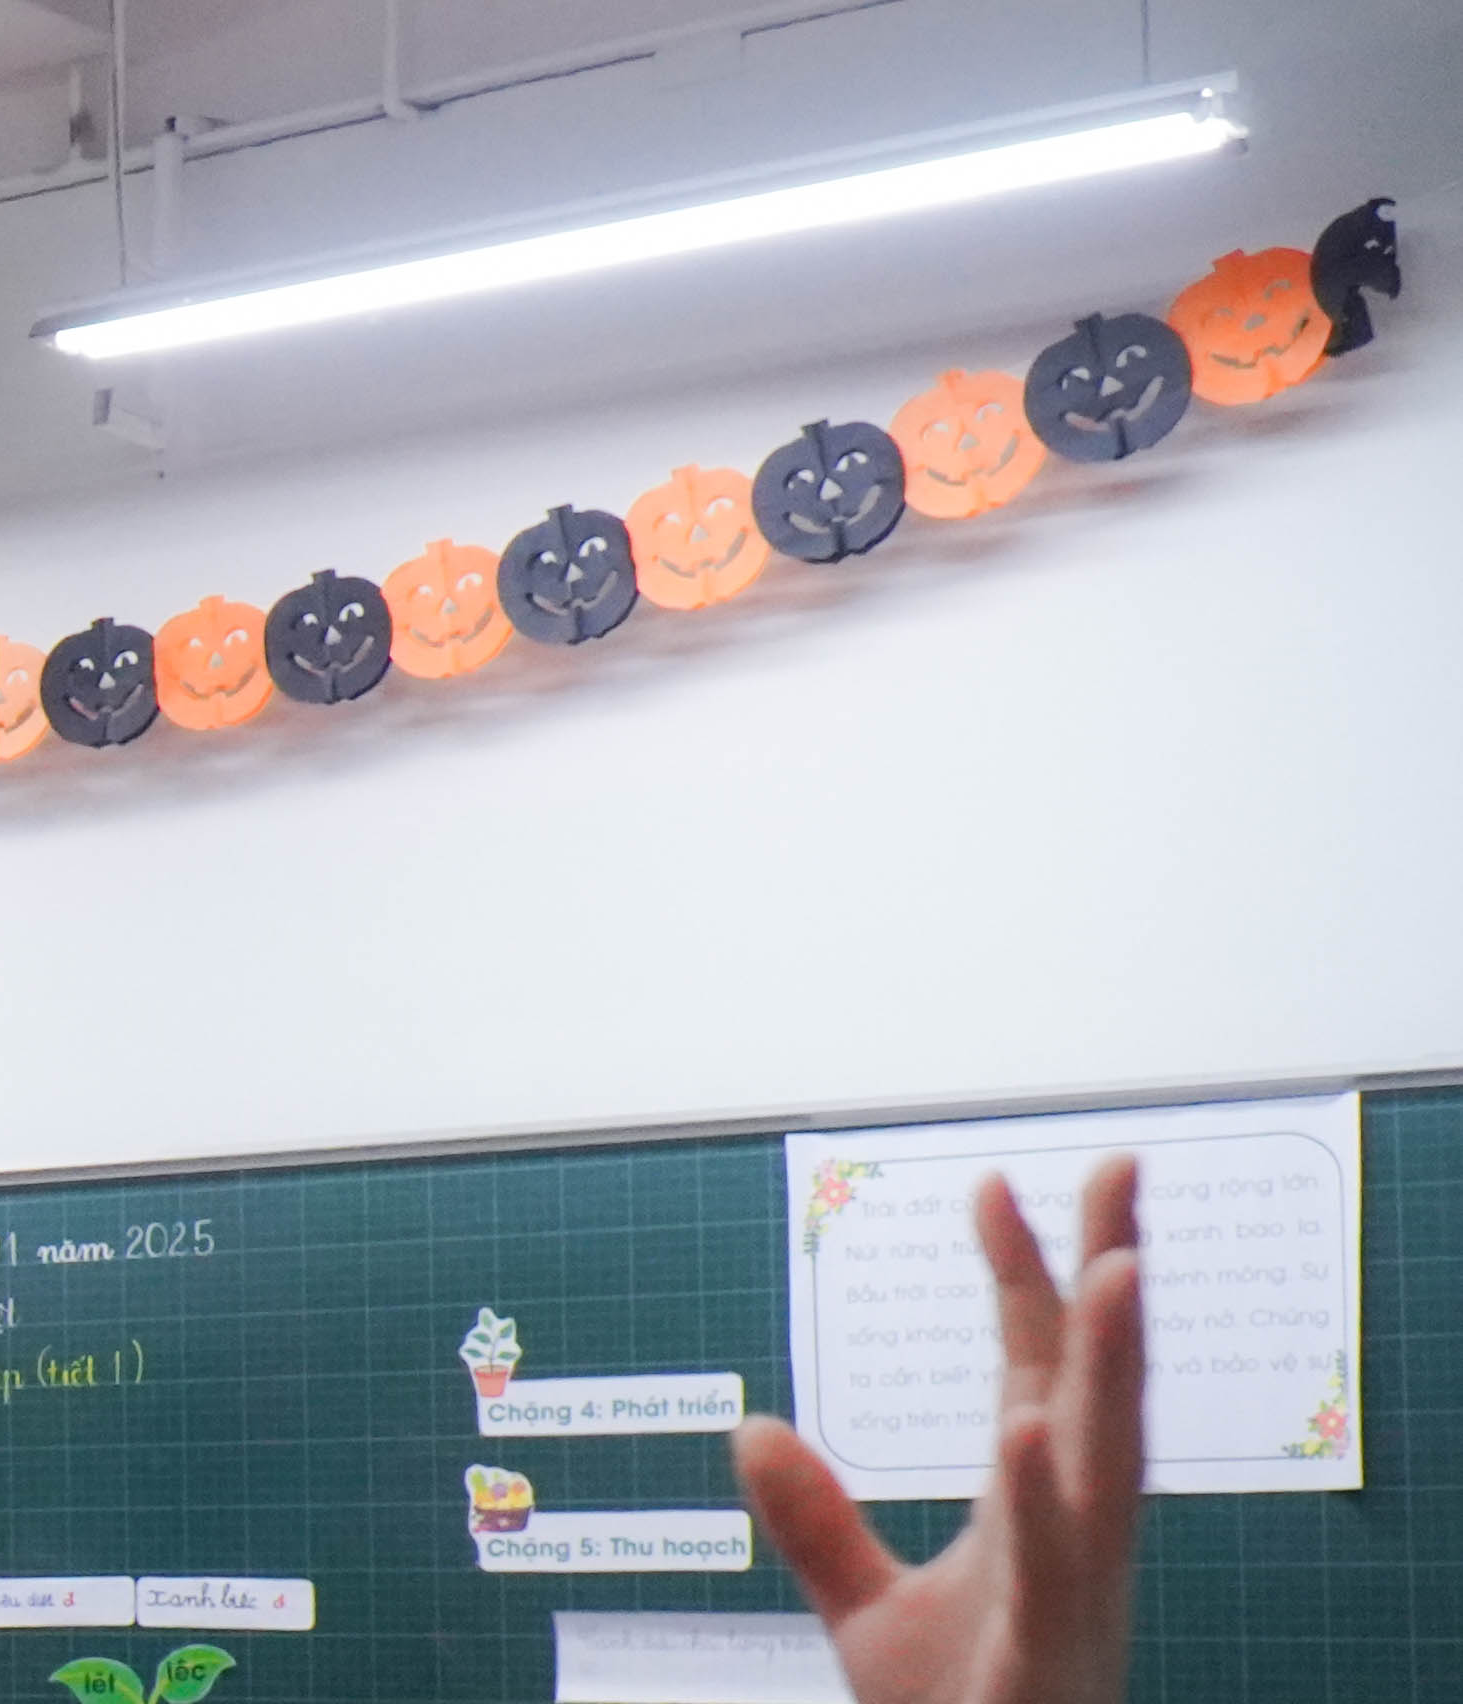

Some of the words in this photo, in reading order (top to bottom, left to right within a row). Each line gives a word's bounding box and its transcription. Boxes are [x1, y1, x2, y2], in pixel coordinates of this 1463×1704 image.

[37, 1238, 115, 1265] năm
[125, 1218, 215, 1259] 2025
[612, 1395, 670, 1419] Phát
[610, 1536, 653, 1558] Thu
[662, 1535, 746, 1562] hoạch
